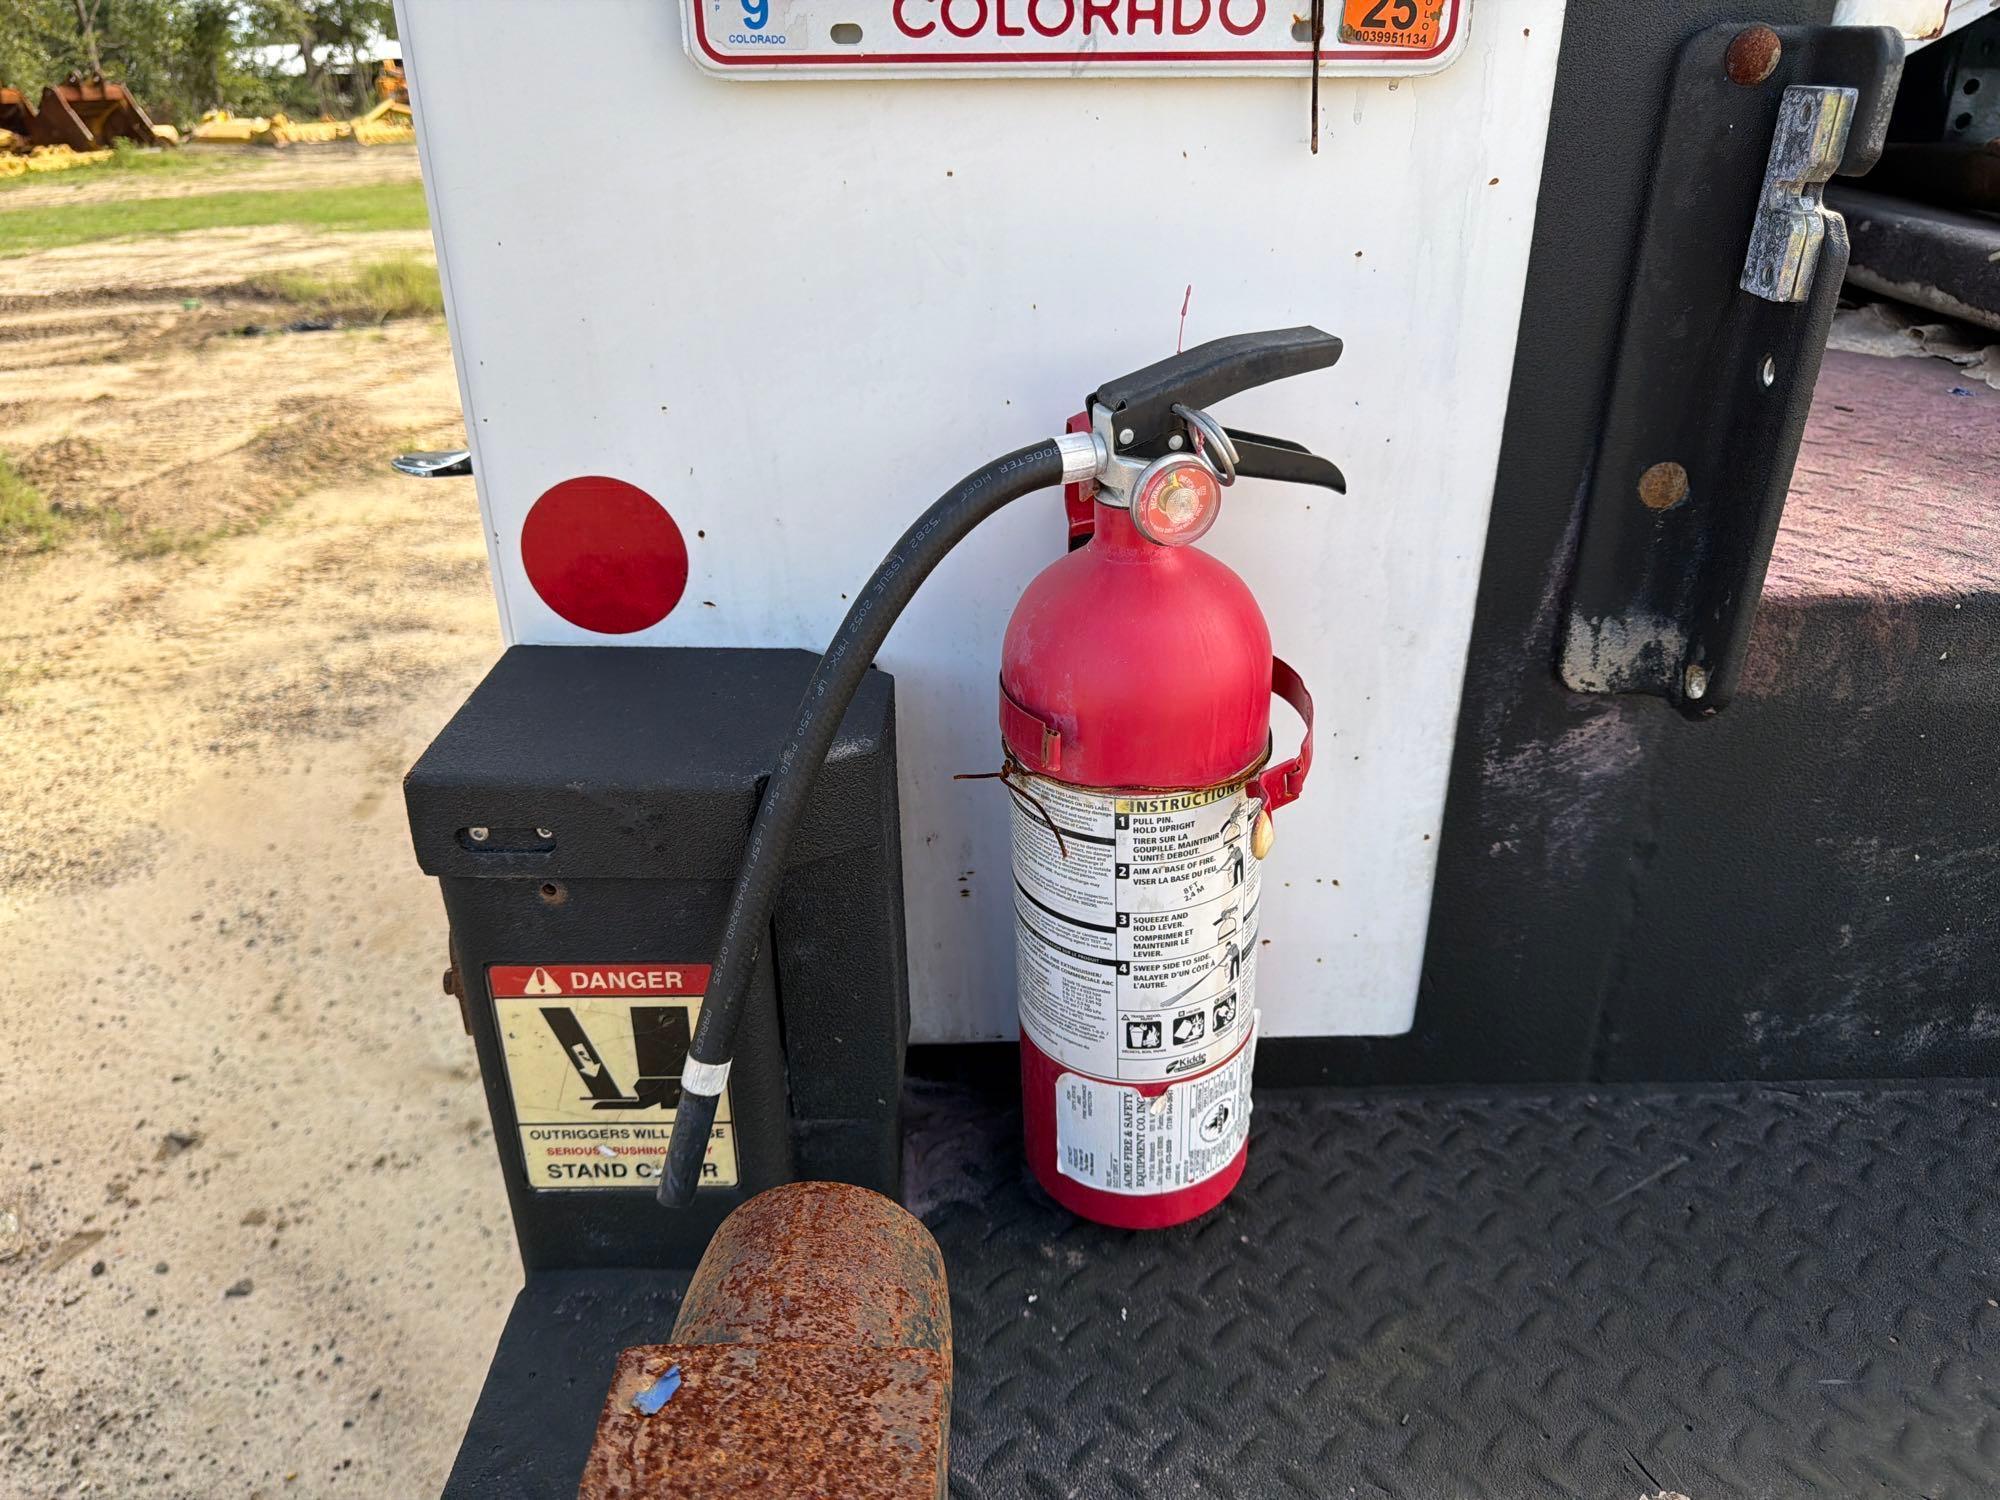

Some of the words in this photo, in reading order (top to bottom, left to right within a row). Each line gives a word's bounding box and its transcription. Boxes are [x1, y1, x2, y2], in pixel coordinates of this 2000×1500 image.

[892, 0, 1267, 38] COLORADO
[1361, 0, 1418, 30] 25
[728, 34, 786, 44] COLORADO
[874, 553, 904, 594] ISSUE
[1119, 817, 1125, 827] 1
[1133, 817, 1153, 825] PULL
[1157, 816, 1174, 824] PIN.
[1160, 820, 1195, 832] UPRIGHT
[1133, 844, 1176, 853] GOUPILLE.
[1178, 832, 1220, 850] MAINTENIR
[1160, 835, 1175, 843] SUR
[1178, 833, 1188, 841] LA
[1093, 850, 1112, 858] damage
[1167, 848, 1200, 860] DEBOUT.
[1133, 867, 1150, 875] AIM
[1152, 866, 1162, 874] AT
[1165, 863, 1184, 873] BASE
[1187, 861, 1198, 869] OF
[1200, 856, 1216, 866] FIRE.
[1119, 868, 1127, 877] 2
[1171, 873, 1189, 883] BASE
[1192, 871, 1202, 879] DU
[1204, 865, 1218, 875] FEU.
[1189, 882, 1199, 892] FT
[1197, 885, 1204, 893] M
[1119, 914, 1127, 924] 3
[1133, 915, 1169, 924] SQUEEZE
[1171, 912, 1188, 920] AND
[1133, 924, 1156, 932] HOLD
[1158, 921, 1184, 930] LEVER.
[1133, 932, 1183, 941] COMPRIMER
[1133, 941, 1178, 950] MAINTENIR
[1078, 954, 1099, 963] PRODUIT
[1133, 950, 1163, 958] LEVIER.
[1119, 963, 1127, 973] 4
[1133, 963, 1160, 972] SWEEP
[1162, 961, 1180, 970] SIDE
[1182, 959, 1192, 967] TO
[1194, 954, 1211, 964] SIDE.
[571, 971, 683, 989] DANGER
[1061, 968, 1100, 984] COMMERCIALE
[1133, 973, 1169, 982] BALAYER
[1171, 969, 1189, 978] D'UN
[694, 1008, 713, 1056] PARKER
[1179, 1053, 1206, 1067] Kidde
[1124, 1092, 1132, 1128] SAFETY
[1137, 1115, 1145, 1130] CO.
[530, 1128, 630, 1140] OUTRIGGERS
[634, 1128, 669, 1140] WILL
[547, 1146, 600, 1156] SERIOUS
[608, 1146, 667, 1156] RUSHING
[1124, 1139, 1133, 1161] FIRE
[1136, 1133, 1146, 1187] EQUIPMENT
[547, 1163, 627, 1179] STAND
[1124, 1162, 1133, 1188] ACME
